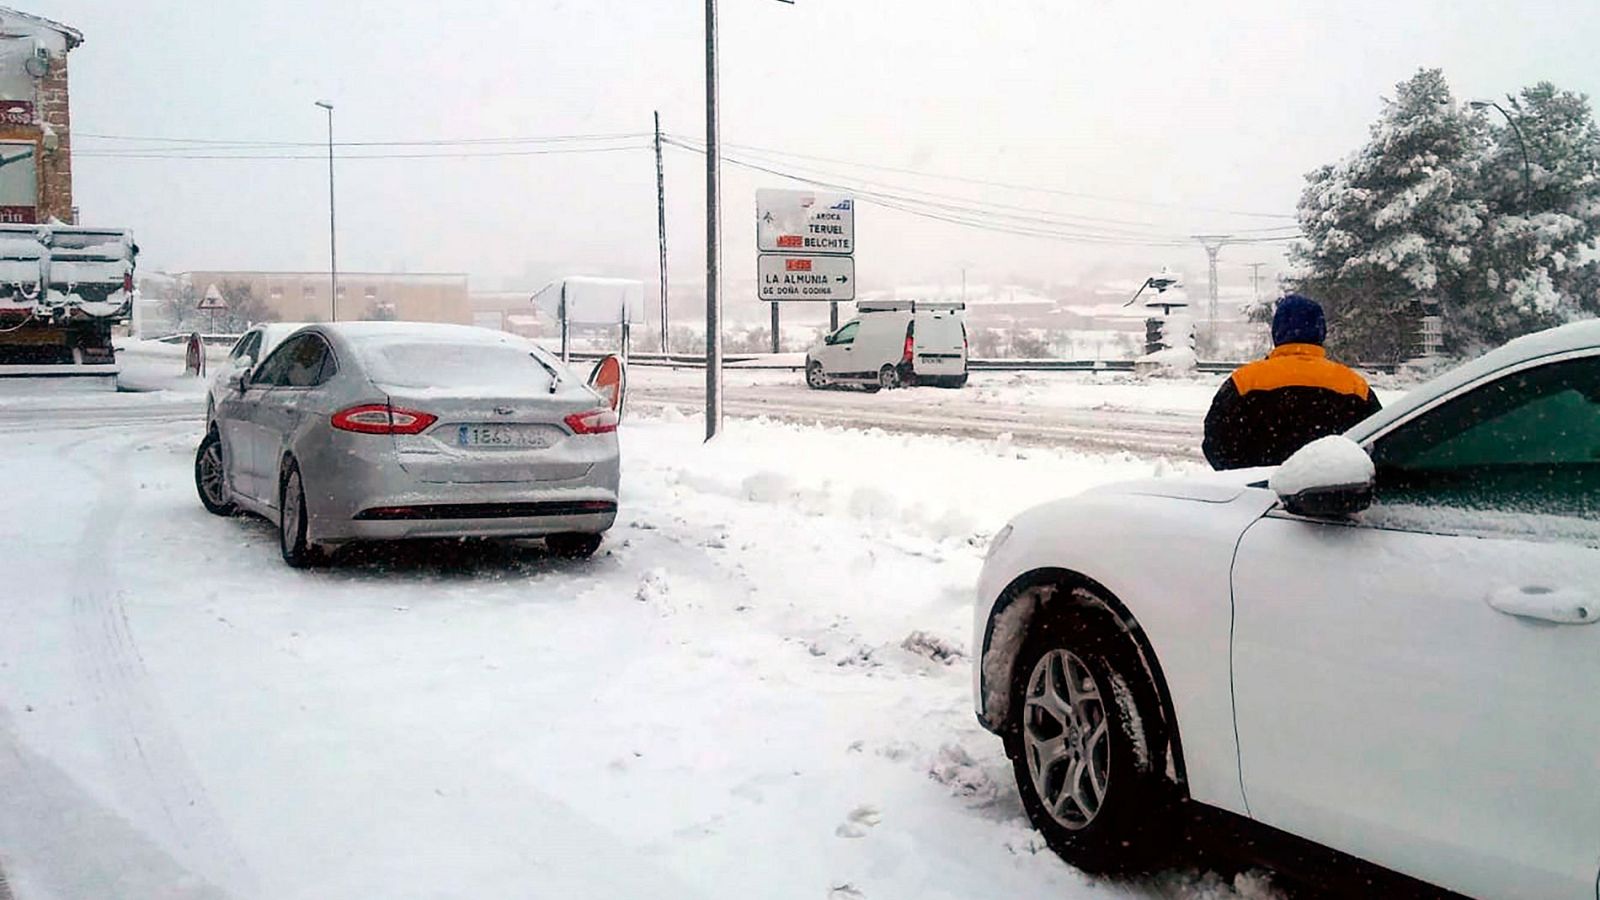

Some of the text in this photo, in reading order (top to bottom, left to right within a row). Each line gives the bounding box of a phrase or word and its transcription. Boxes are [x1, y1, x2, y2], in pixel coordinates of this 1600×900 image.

[810, 212, 841, 221] AROCA
[808, 224, 844, 235] TERUEL
[804, 237, 850, 248] BELCHITE
[765, 274, 828, 284] LA ALMUNIA
[763, 285, 832, 295] DE DOÑA GODINA
